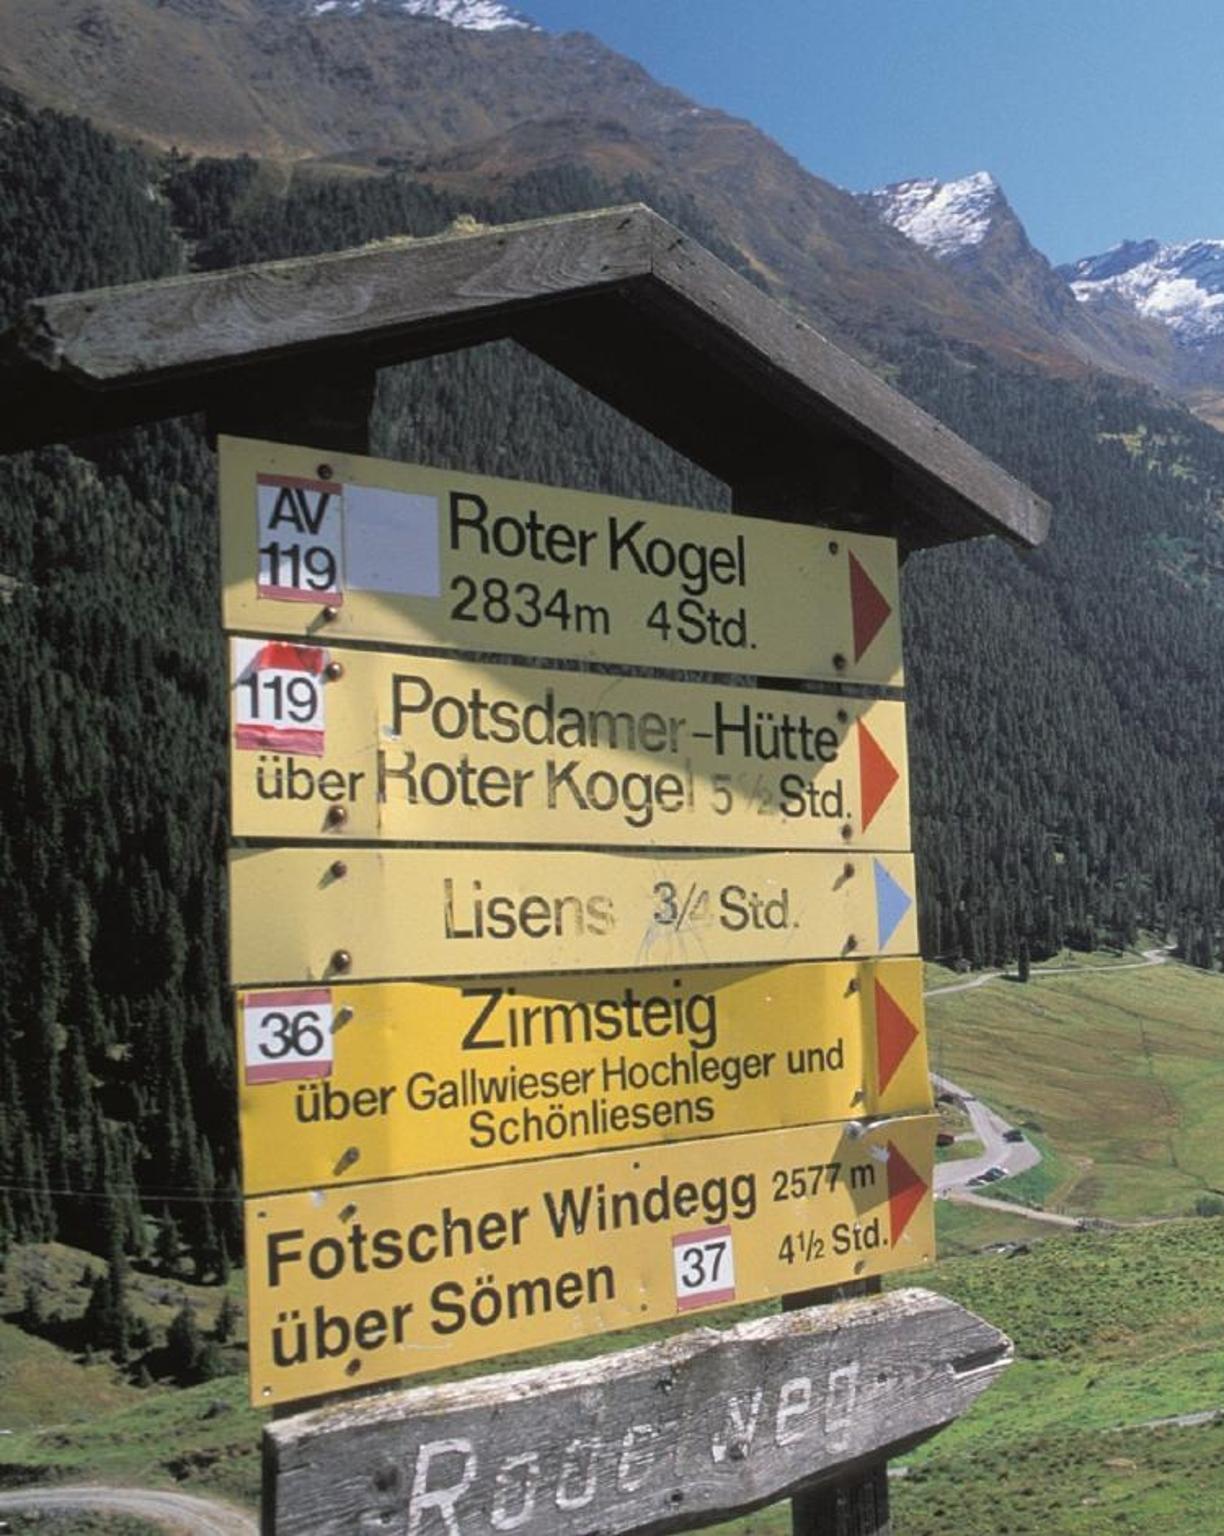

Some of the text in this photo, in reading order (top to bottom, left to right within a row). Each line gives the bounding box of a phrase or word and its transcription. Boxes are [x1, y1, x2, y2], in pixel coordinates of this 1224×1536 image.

[268, 487, 331, 535] AV
[258, 541, 337, 591] 119
[448, 492, 746, 597] Roter Kogel
[450, 575, 611, 634] 2834m
[240, 671, 318, 722] 119
[391, 674, 838, 763] Potsdamer-Hütte
[256, 756, 365, 802] über
[378, 750, 534, 808] Roter
[547, 758, 694, 827] Kogel
[779, 774, 851, 817] Std.
[444, 878, 615, 939] Lisens
[719, 885, 799, 931] Std.
[258, 1011, 324, 1060] 36
[462, 979, 717, 1052] Zirmsteig
[296, 1039, 845, 1123] über Gallwieser Hochleger und
[470, 1092, 715, 1149] Schönliesens
[266, 1162, 876, 1288] Fotscher Windegg 2577 m
[831, 1217, 888, 1255] Std.
[681, 1242, 728, 1290] 37
[271, 1262, 615, 1370] über Sömen
